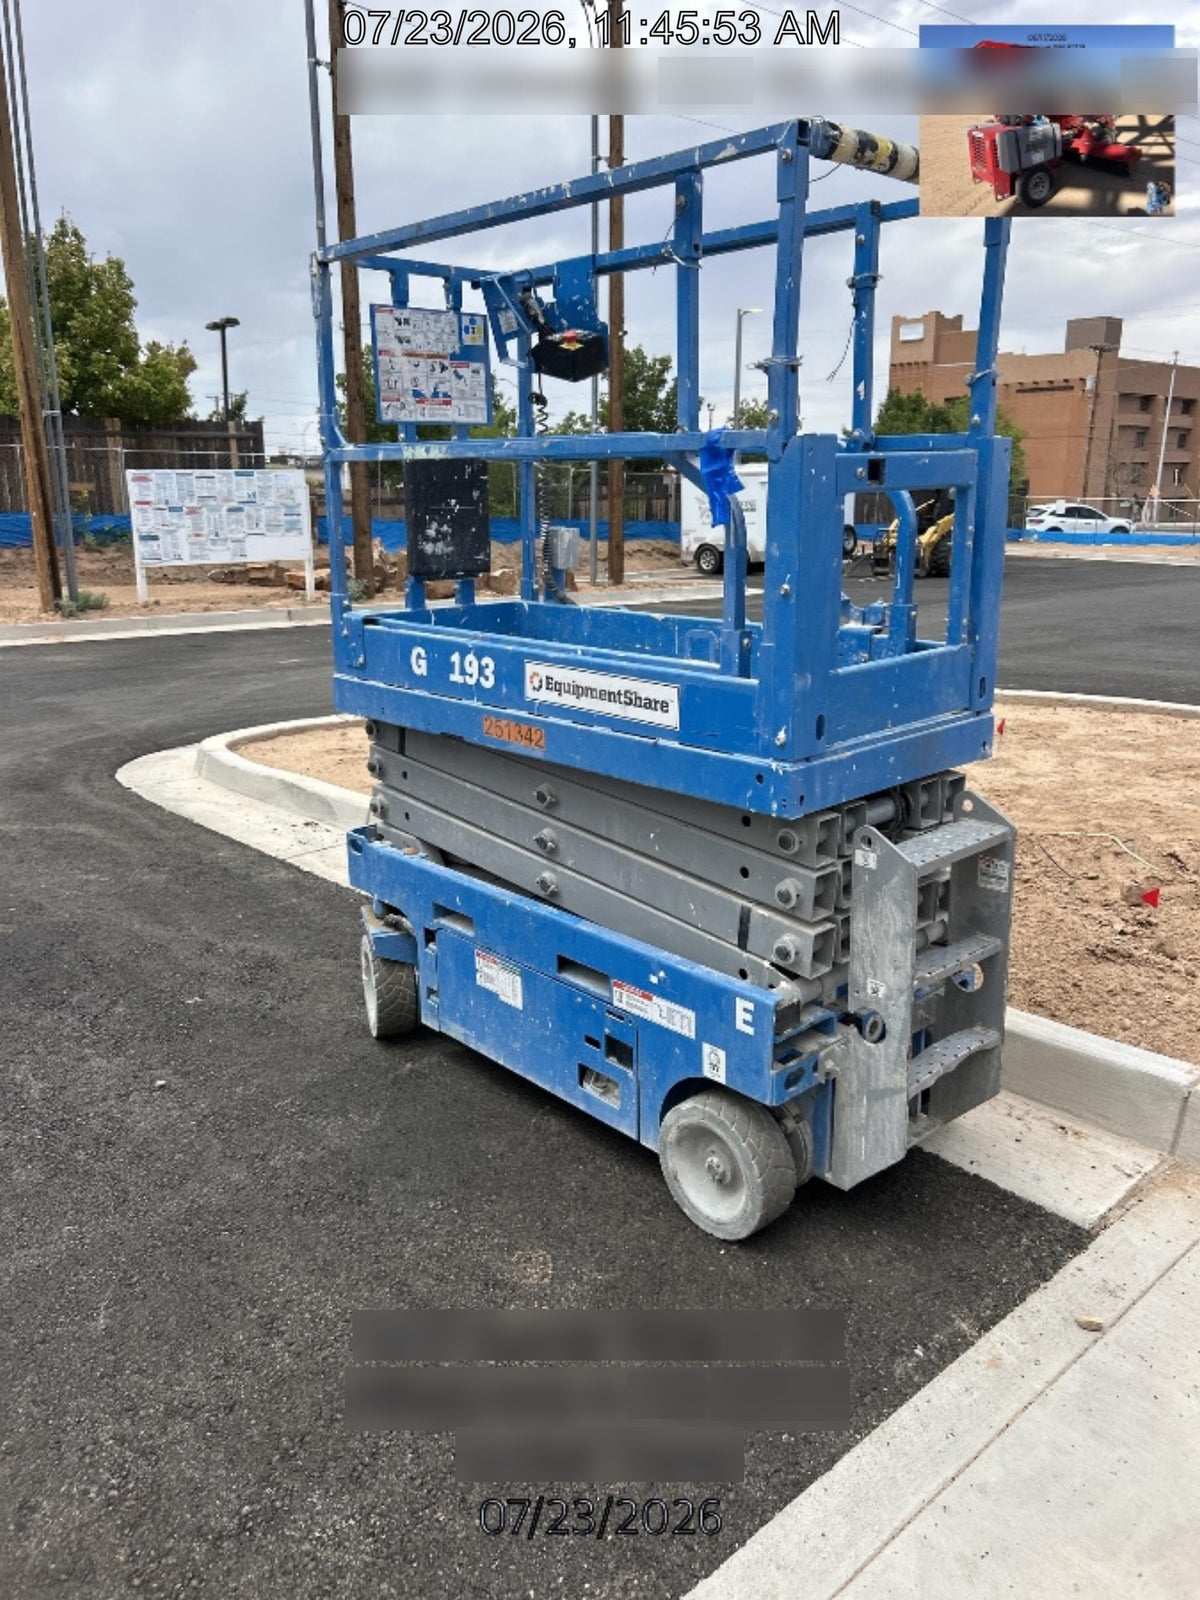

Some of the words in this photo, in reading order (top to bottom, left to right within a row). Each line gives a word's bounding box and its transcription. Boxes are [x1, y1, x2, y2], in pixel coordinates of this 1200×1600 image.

[410, 646, 428, 677] G
[449, 651, 496, 689] 193
[545, 675, 670, 713] EquipmentShare
[484, 716, 544, 748] 251342
[735, 996, 755, 1036] E
